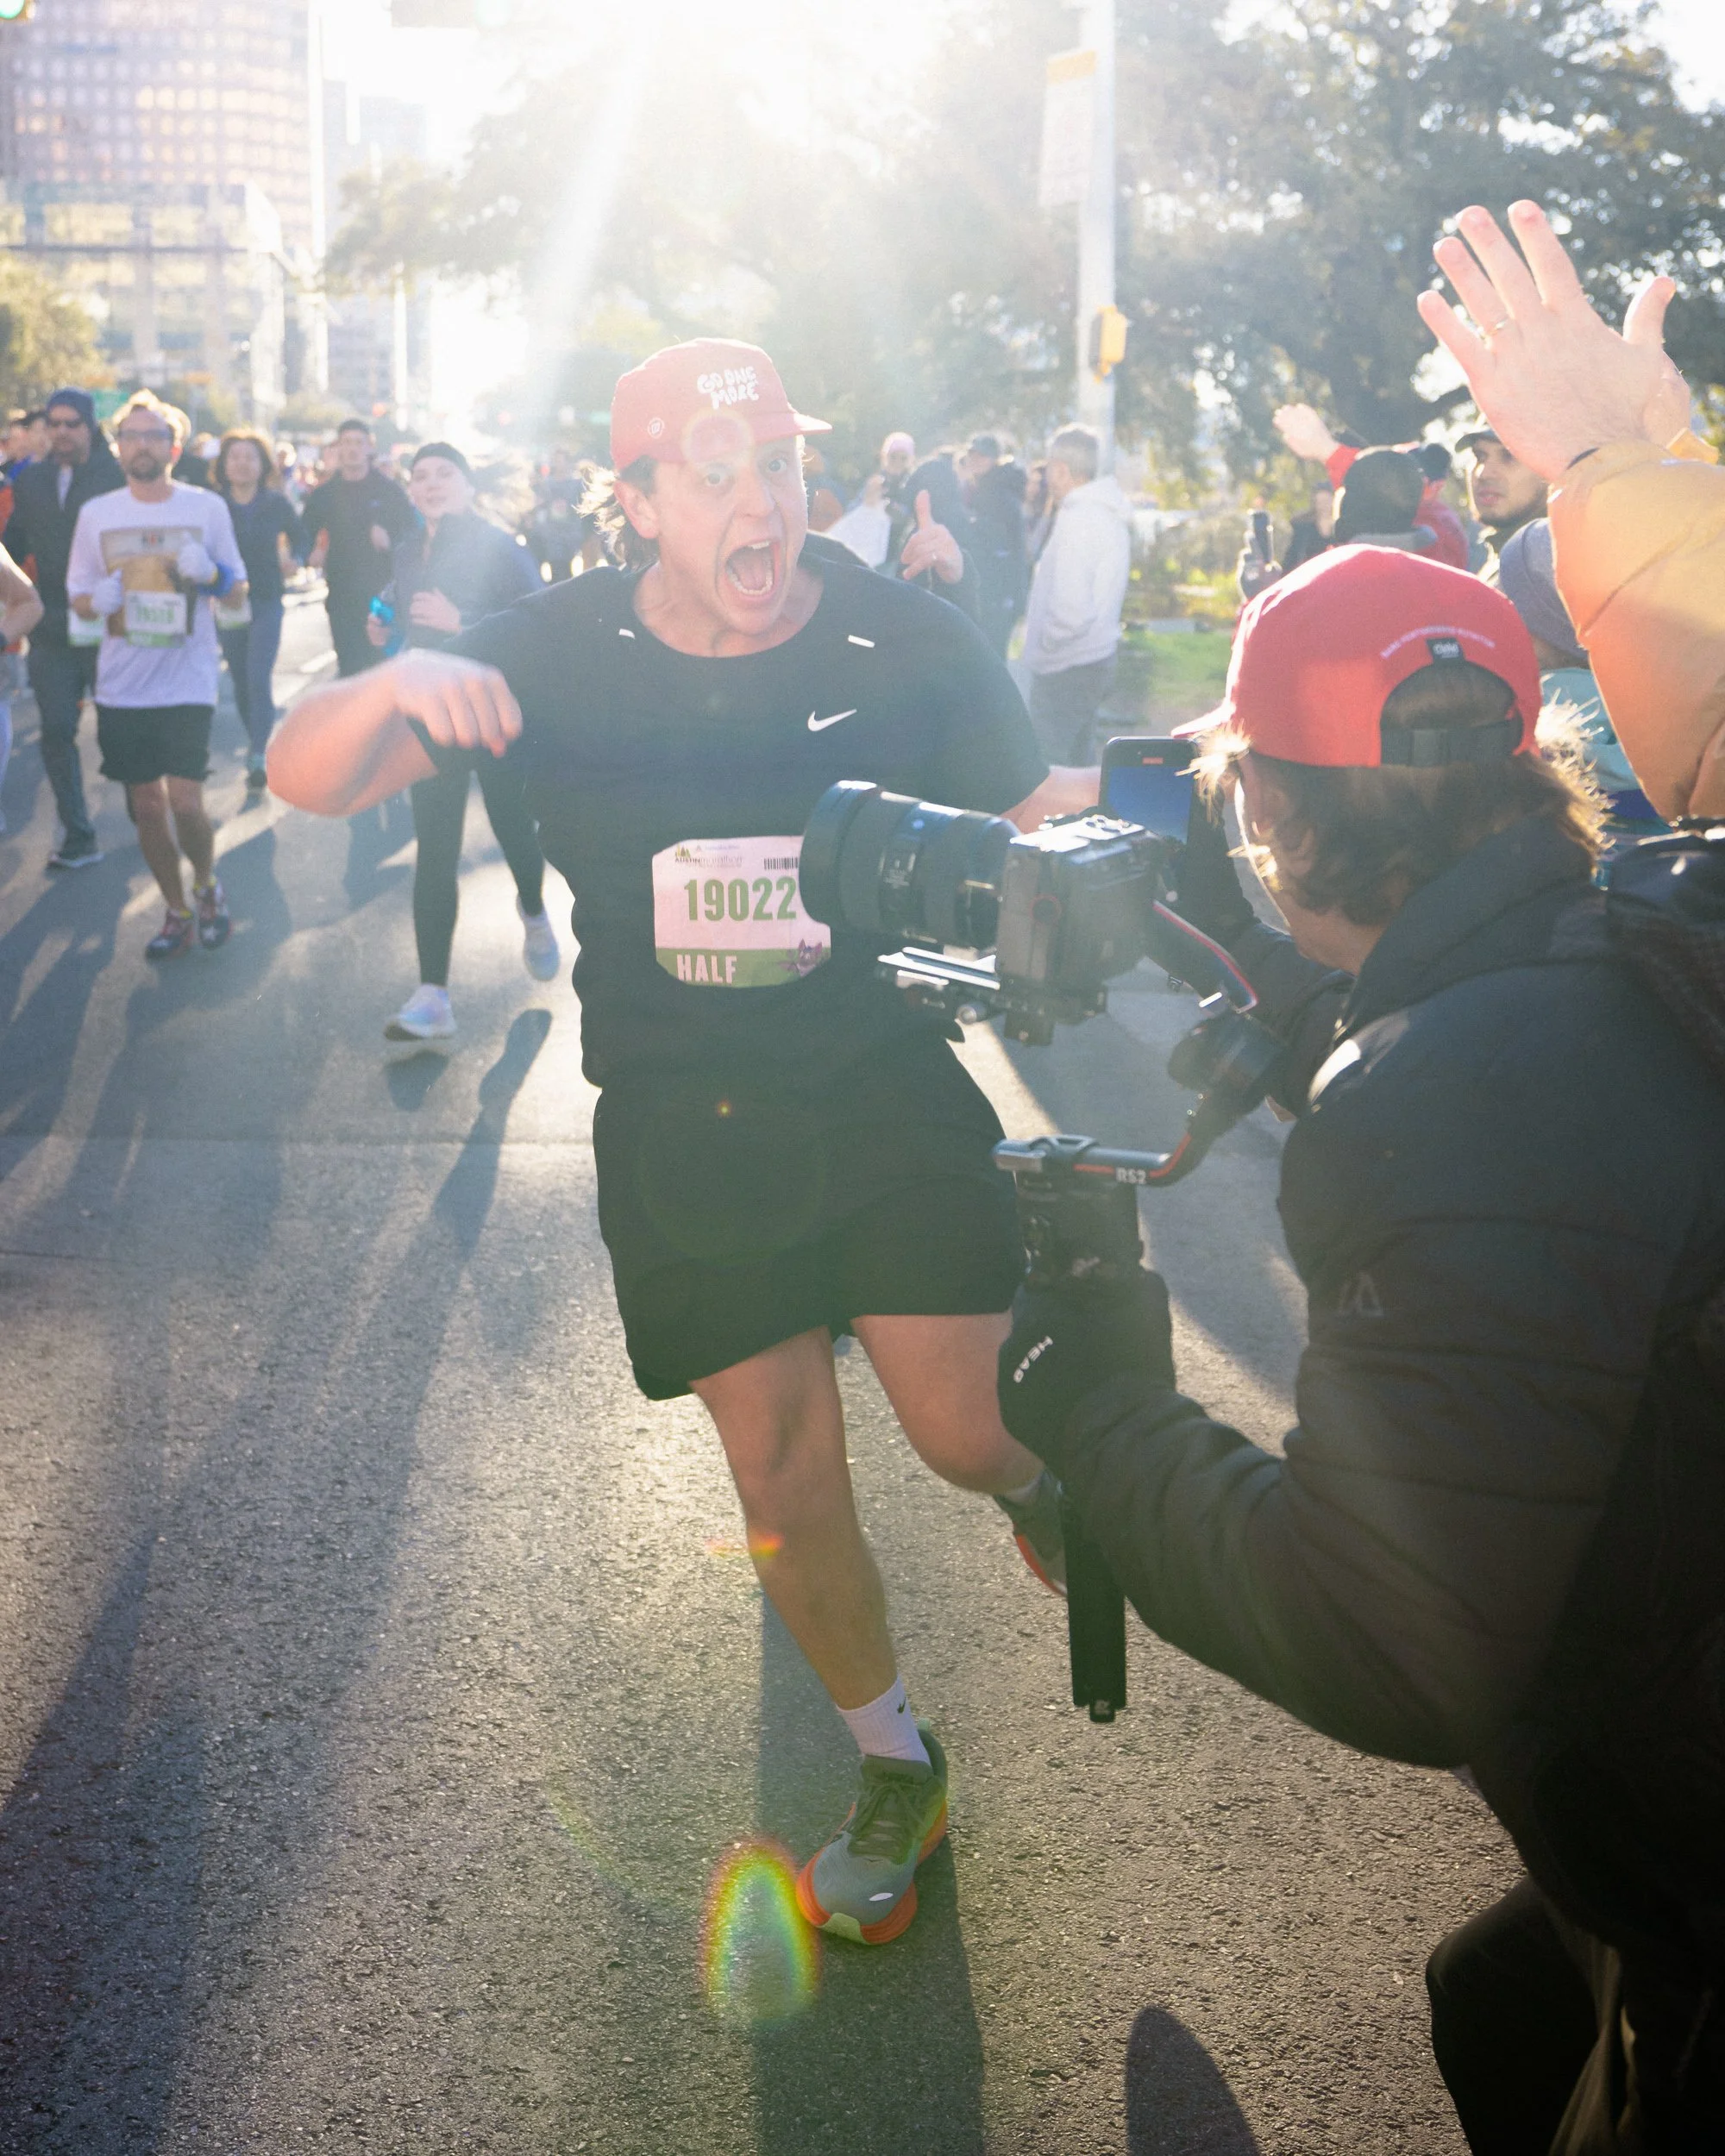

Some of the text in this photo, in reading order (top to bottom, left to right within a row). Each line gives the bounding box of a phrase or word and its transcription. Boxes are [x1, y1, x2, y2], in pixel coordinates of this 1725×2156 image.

[697, 366, 757, 394] GO ONE
[711, 379, 759, 410] MORE
[684, 876, 797, 922] 19022
[677, 954, 737, 984] HALF
[1013, 1335, 1053, 1383] HEAD
